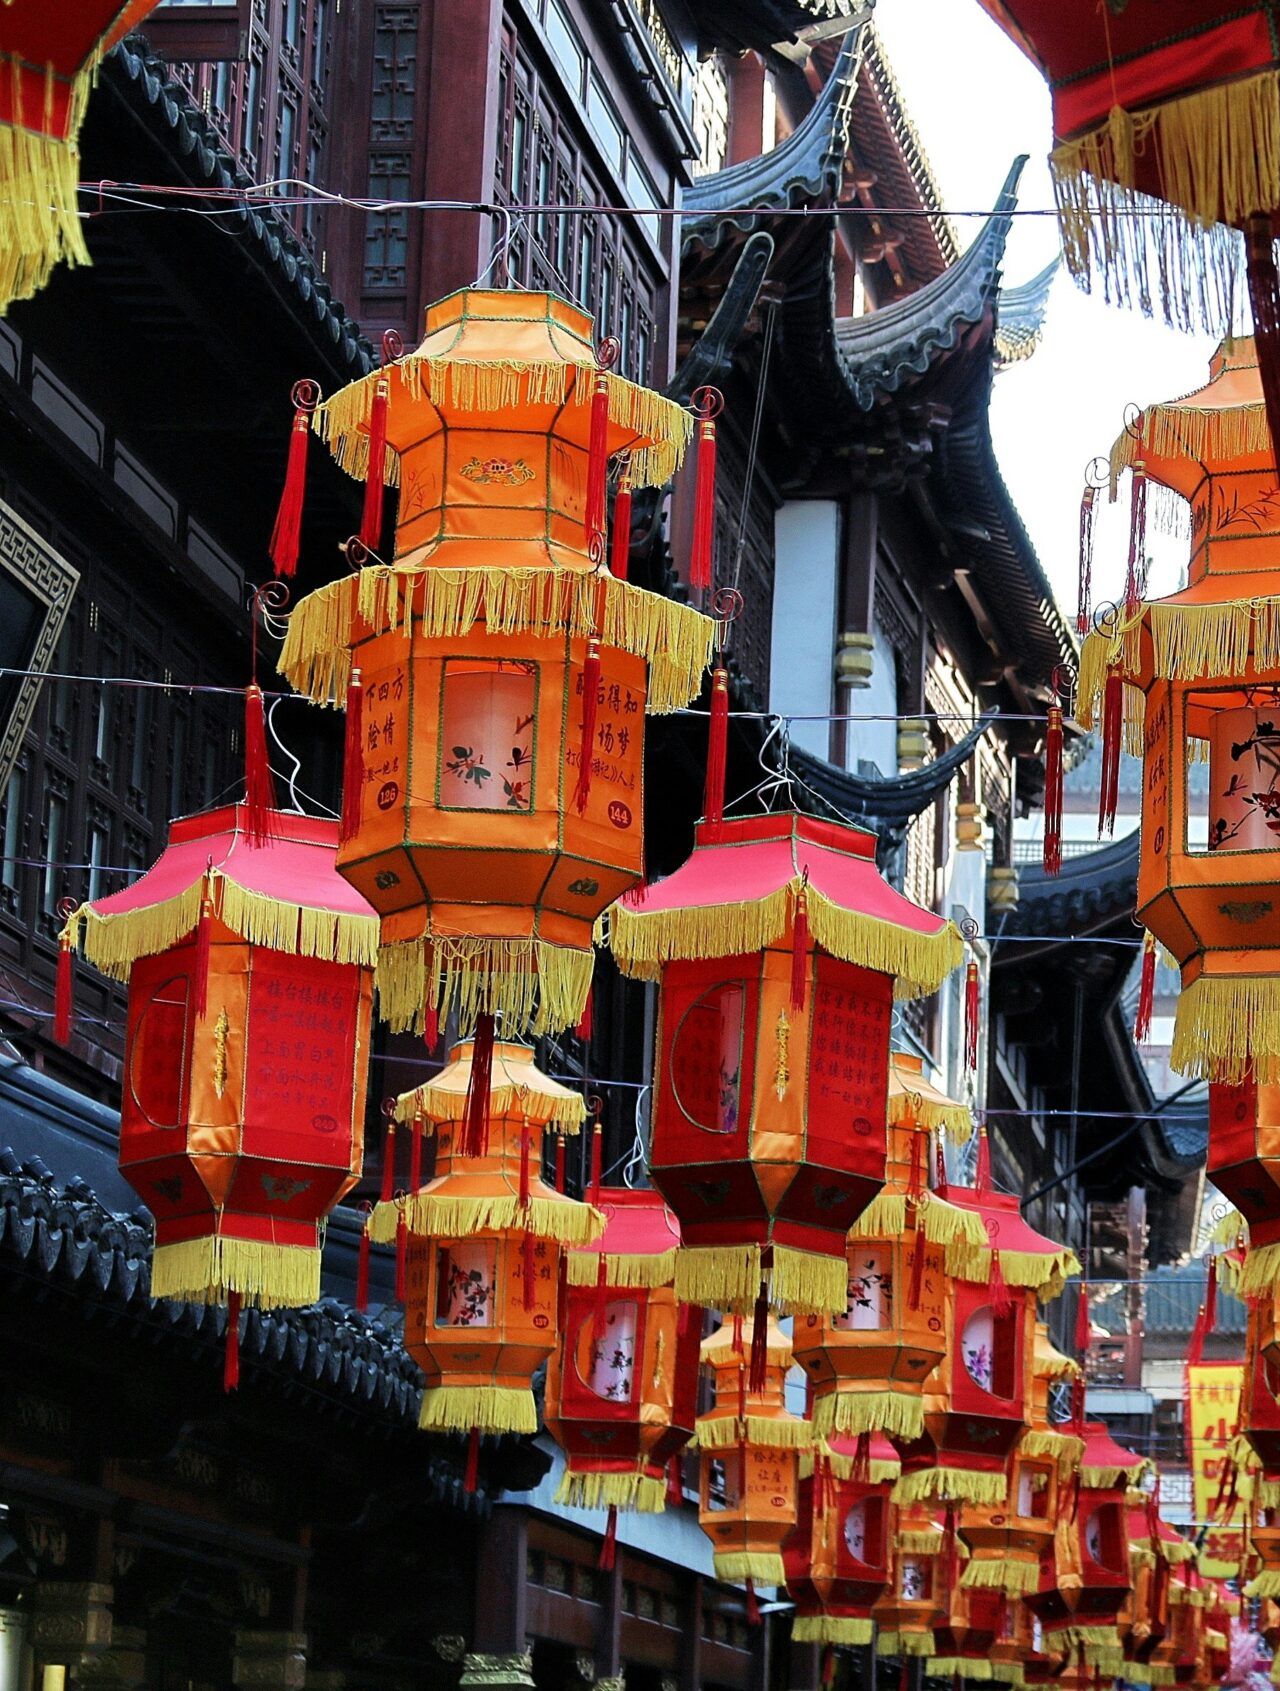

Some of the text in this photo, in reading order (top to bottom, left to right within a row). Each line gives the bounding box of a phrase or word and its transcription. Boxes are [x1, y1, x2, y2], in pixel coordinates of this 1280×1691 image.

[366, 668, 404, 711] 下四方
[367, 712, 396, 751] 险情
[579, 723, 630, 759] 场梦
[609, 804, 630, 826] 144
